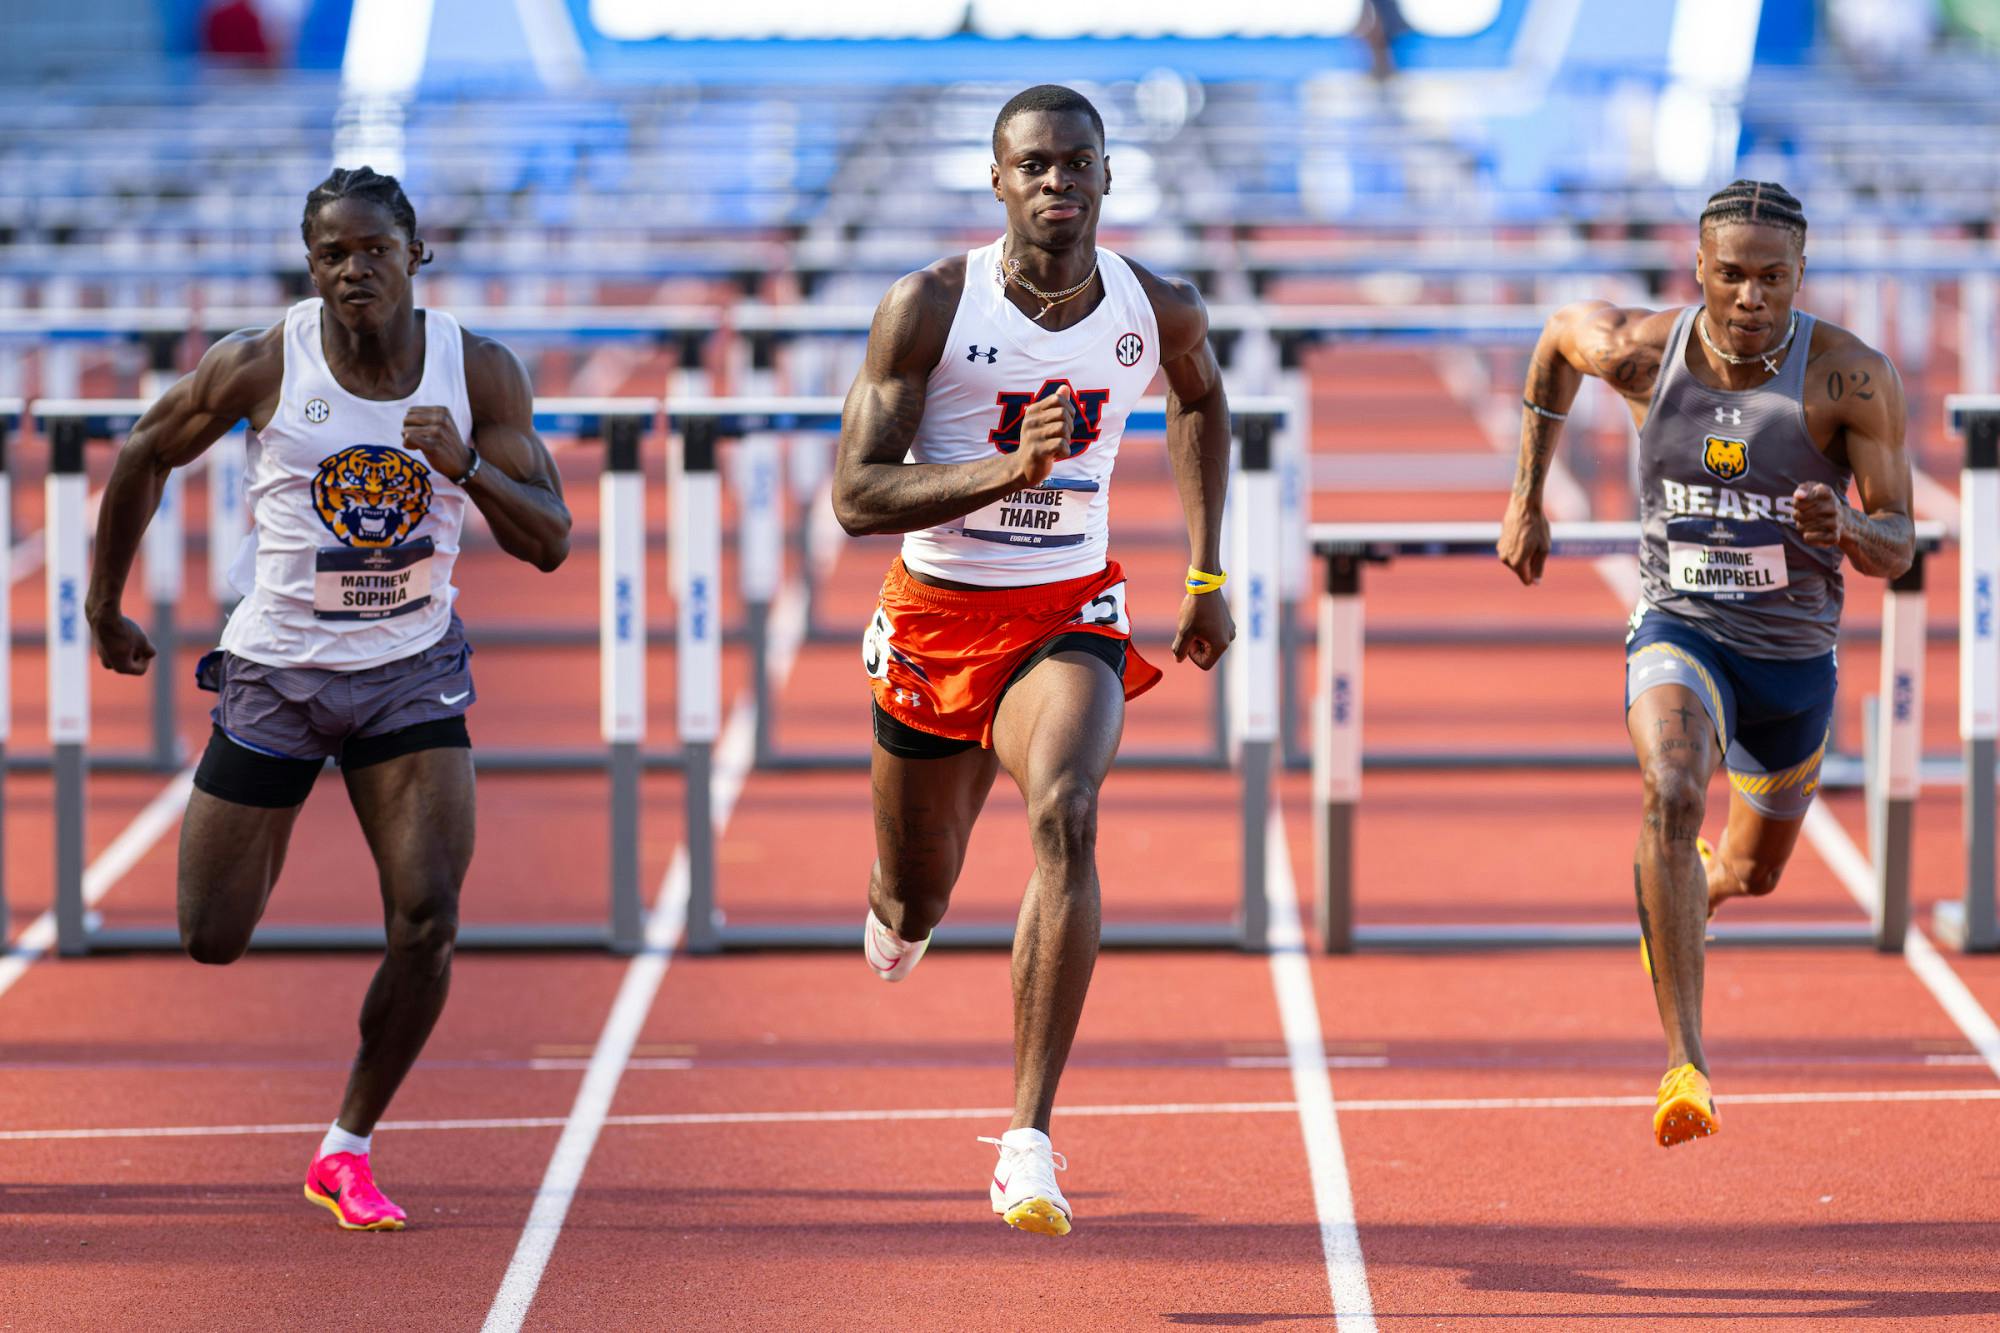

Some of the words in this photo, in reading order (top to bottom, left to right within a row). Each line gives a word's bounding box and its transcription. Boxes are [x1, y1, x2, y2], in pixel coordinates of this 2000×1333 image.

[1117, 333, 1143, 367] SEC
[1826, 370, 1875, 401] 02
[305, 399, 330, 424] SEC
[1000, 507, 1060, 530] THARP
[1700, 549, 1754, 566] JEROME
[341, 570, 411, 588] MATTHEW
[1684, 567, 1775, 587] CAMPBELL
[343, 587, 407, 606] SOPHIA
